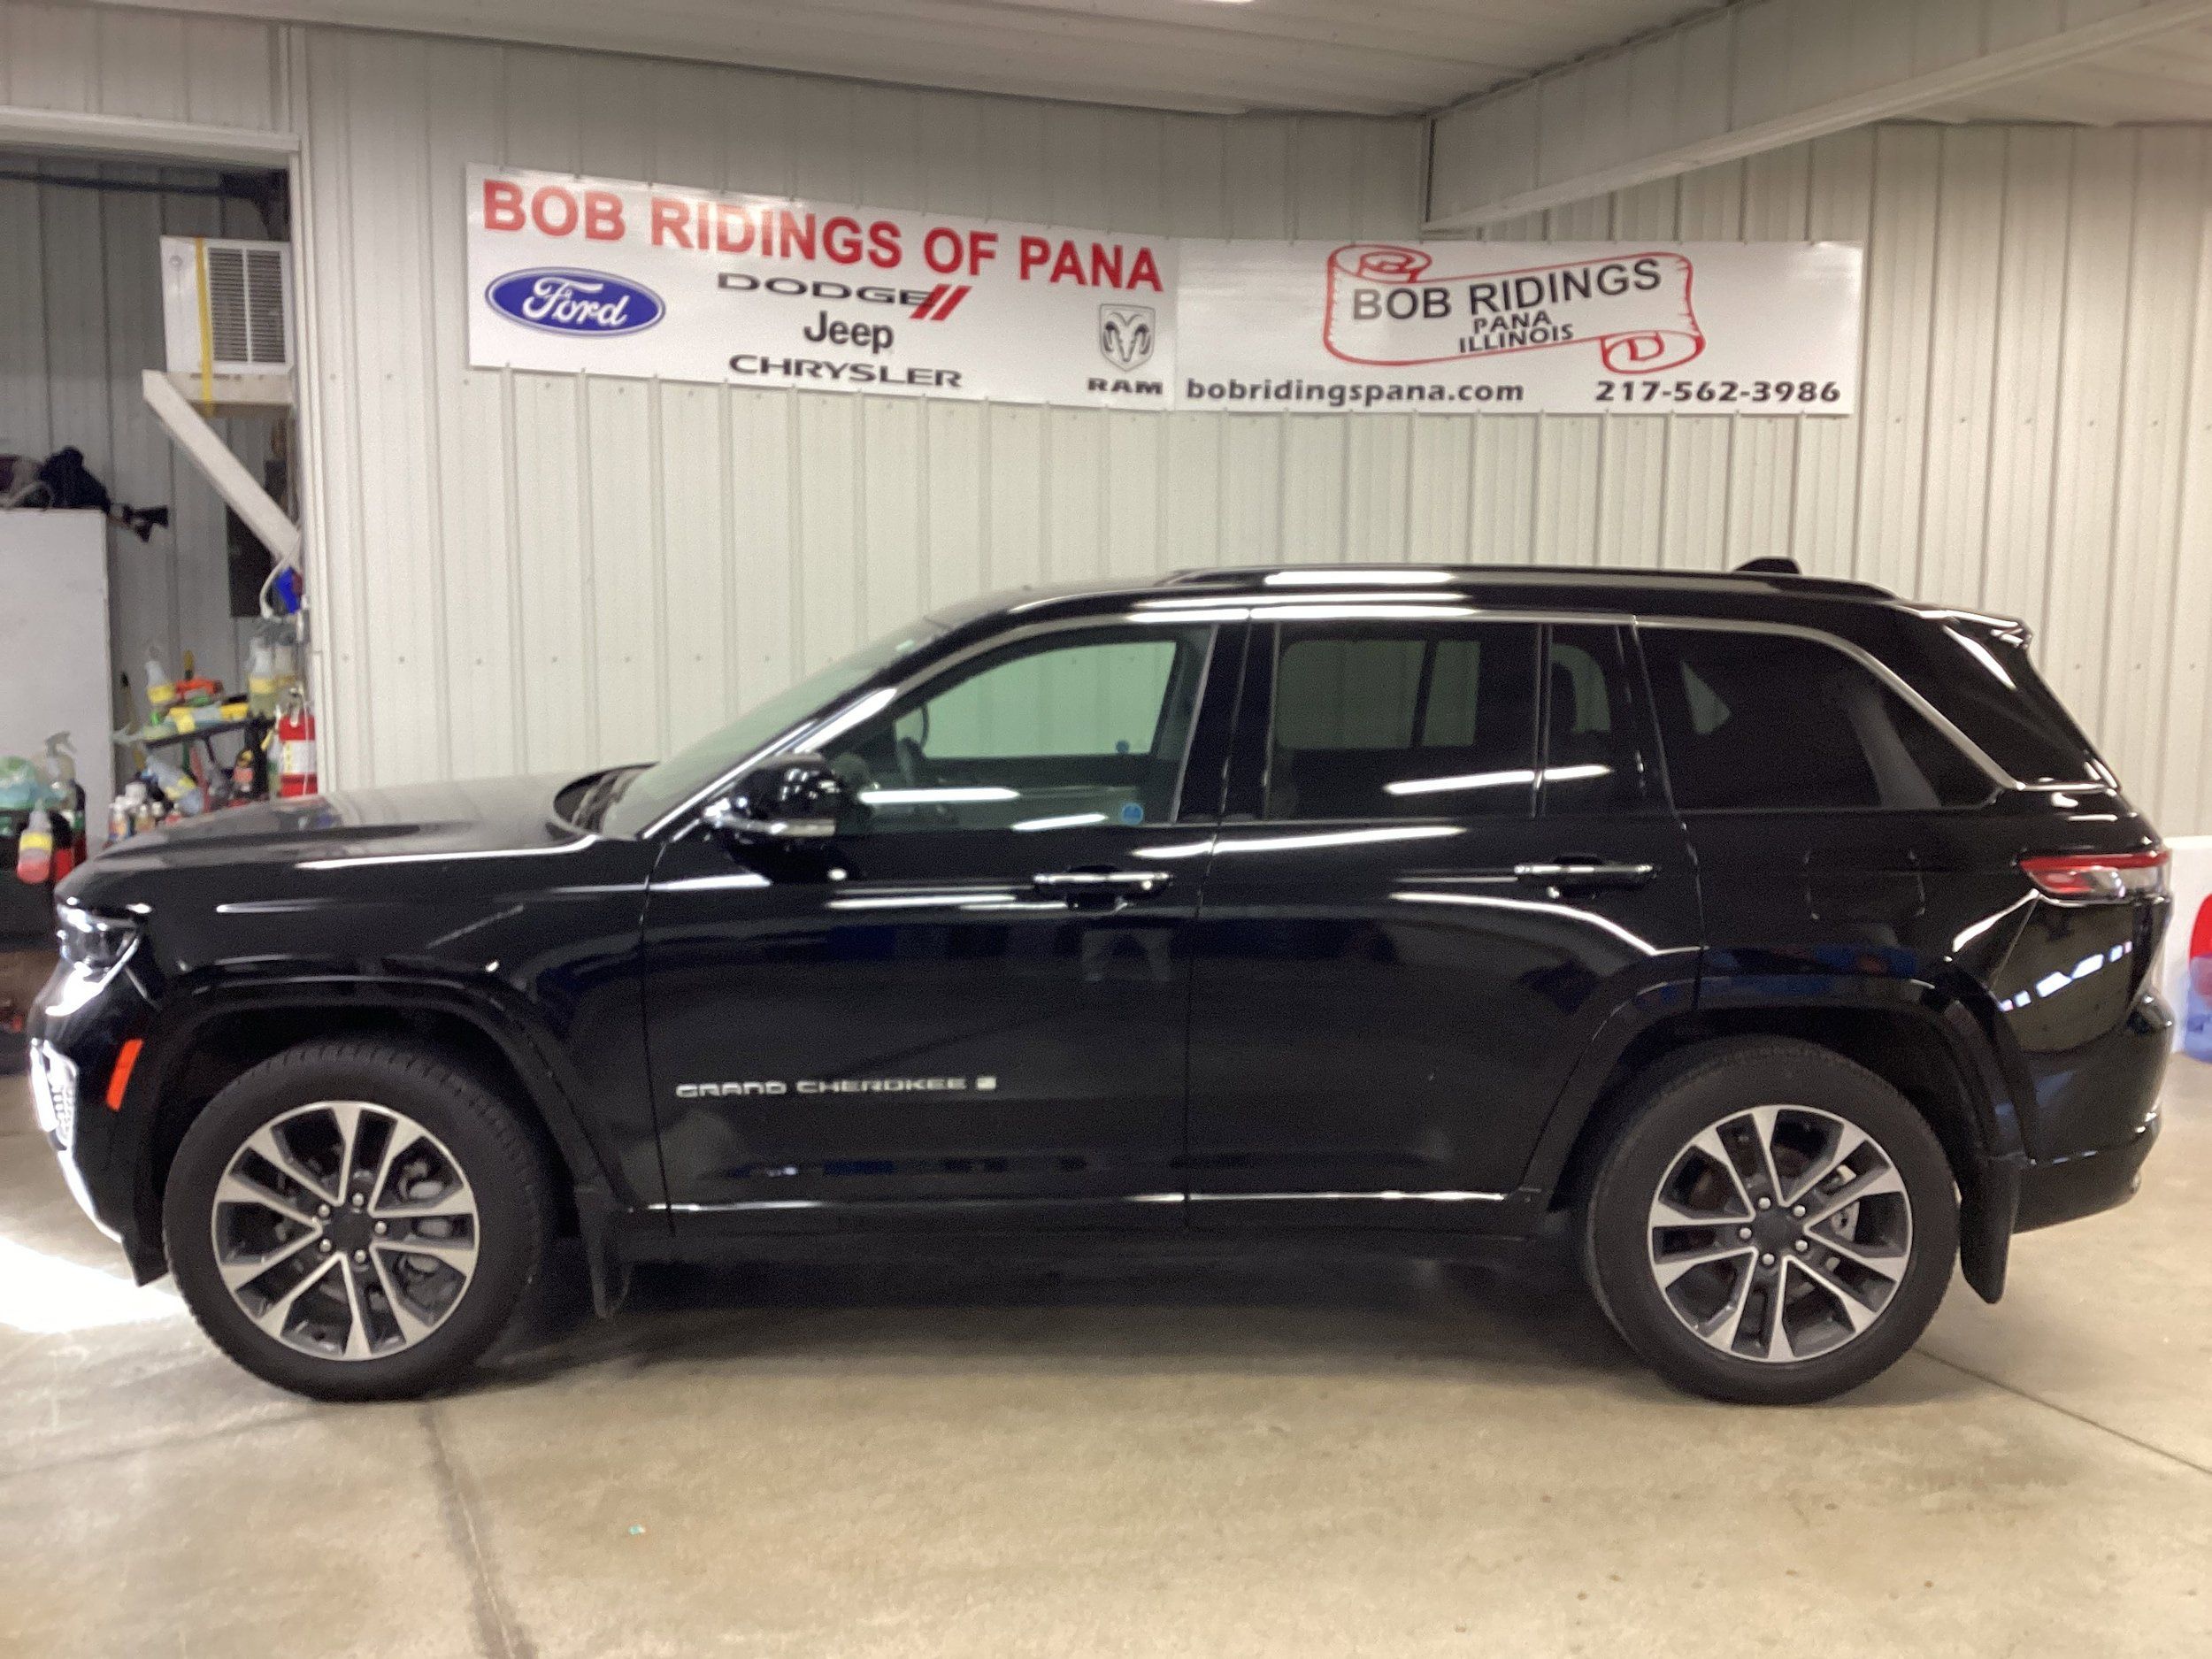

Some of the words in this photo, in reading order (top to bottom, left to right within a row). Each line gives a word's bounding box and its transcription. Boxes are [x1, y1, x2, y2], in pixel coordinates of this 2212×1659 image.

[483, 179, 626, 241] BOB
[651, 196, 902, 268] RIDINGS
[924, 227, 999, 275] OF
[1020, 235, 1164, 292] PANA
[522, 275, 631, 326] Ford
[718, 273, 935, 307] DODGE
[1353, 286, 1452, 320] BOB
[1469, 257, 1662, 315] RIDINGS
[803, 311, 895, 354] Jeep
[1459, 323, 1574, 353] ILLINOIS
[1473, 310, 1553, 334] PANA
[728, 354, 962, 388] CHRYSLER
[1087, 378, 1164, 396] RAM
[1187, 378, 1524, 405] bobridingspana.com
[1596, 380, 1841, 403] 217-562-3986
[676, 1080, 787, 1097] GRAND
[796, 1078, 966, 1094] CHEROKEE
